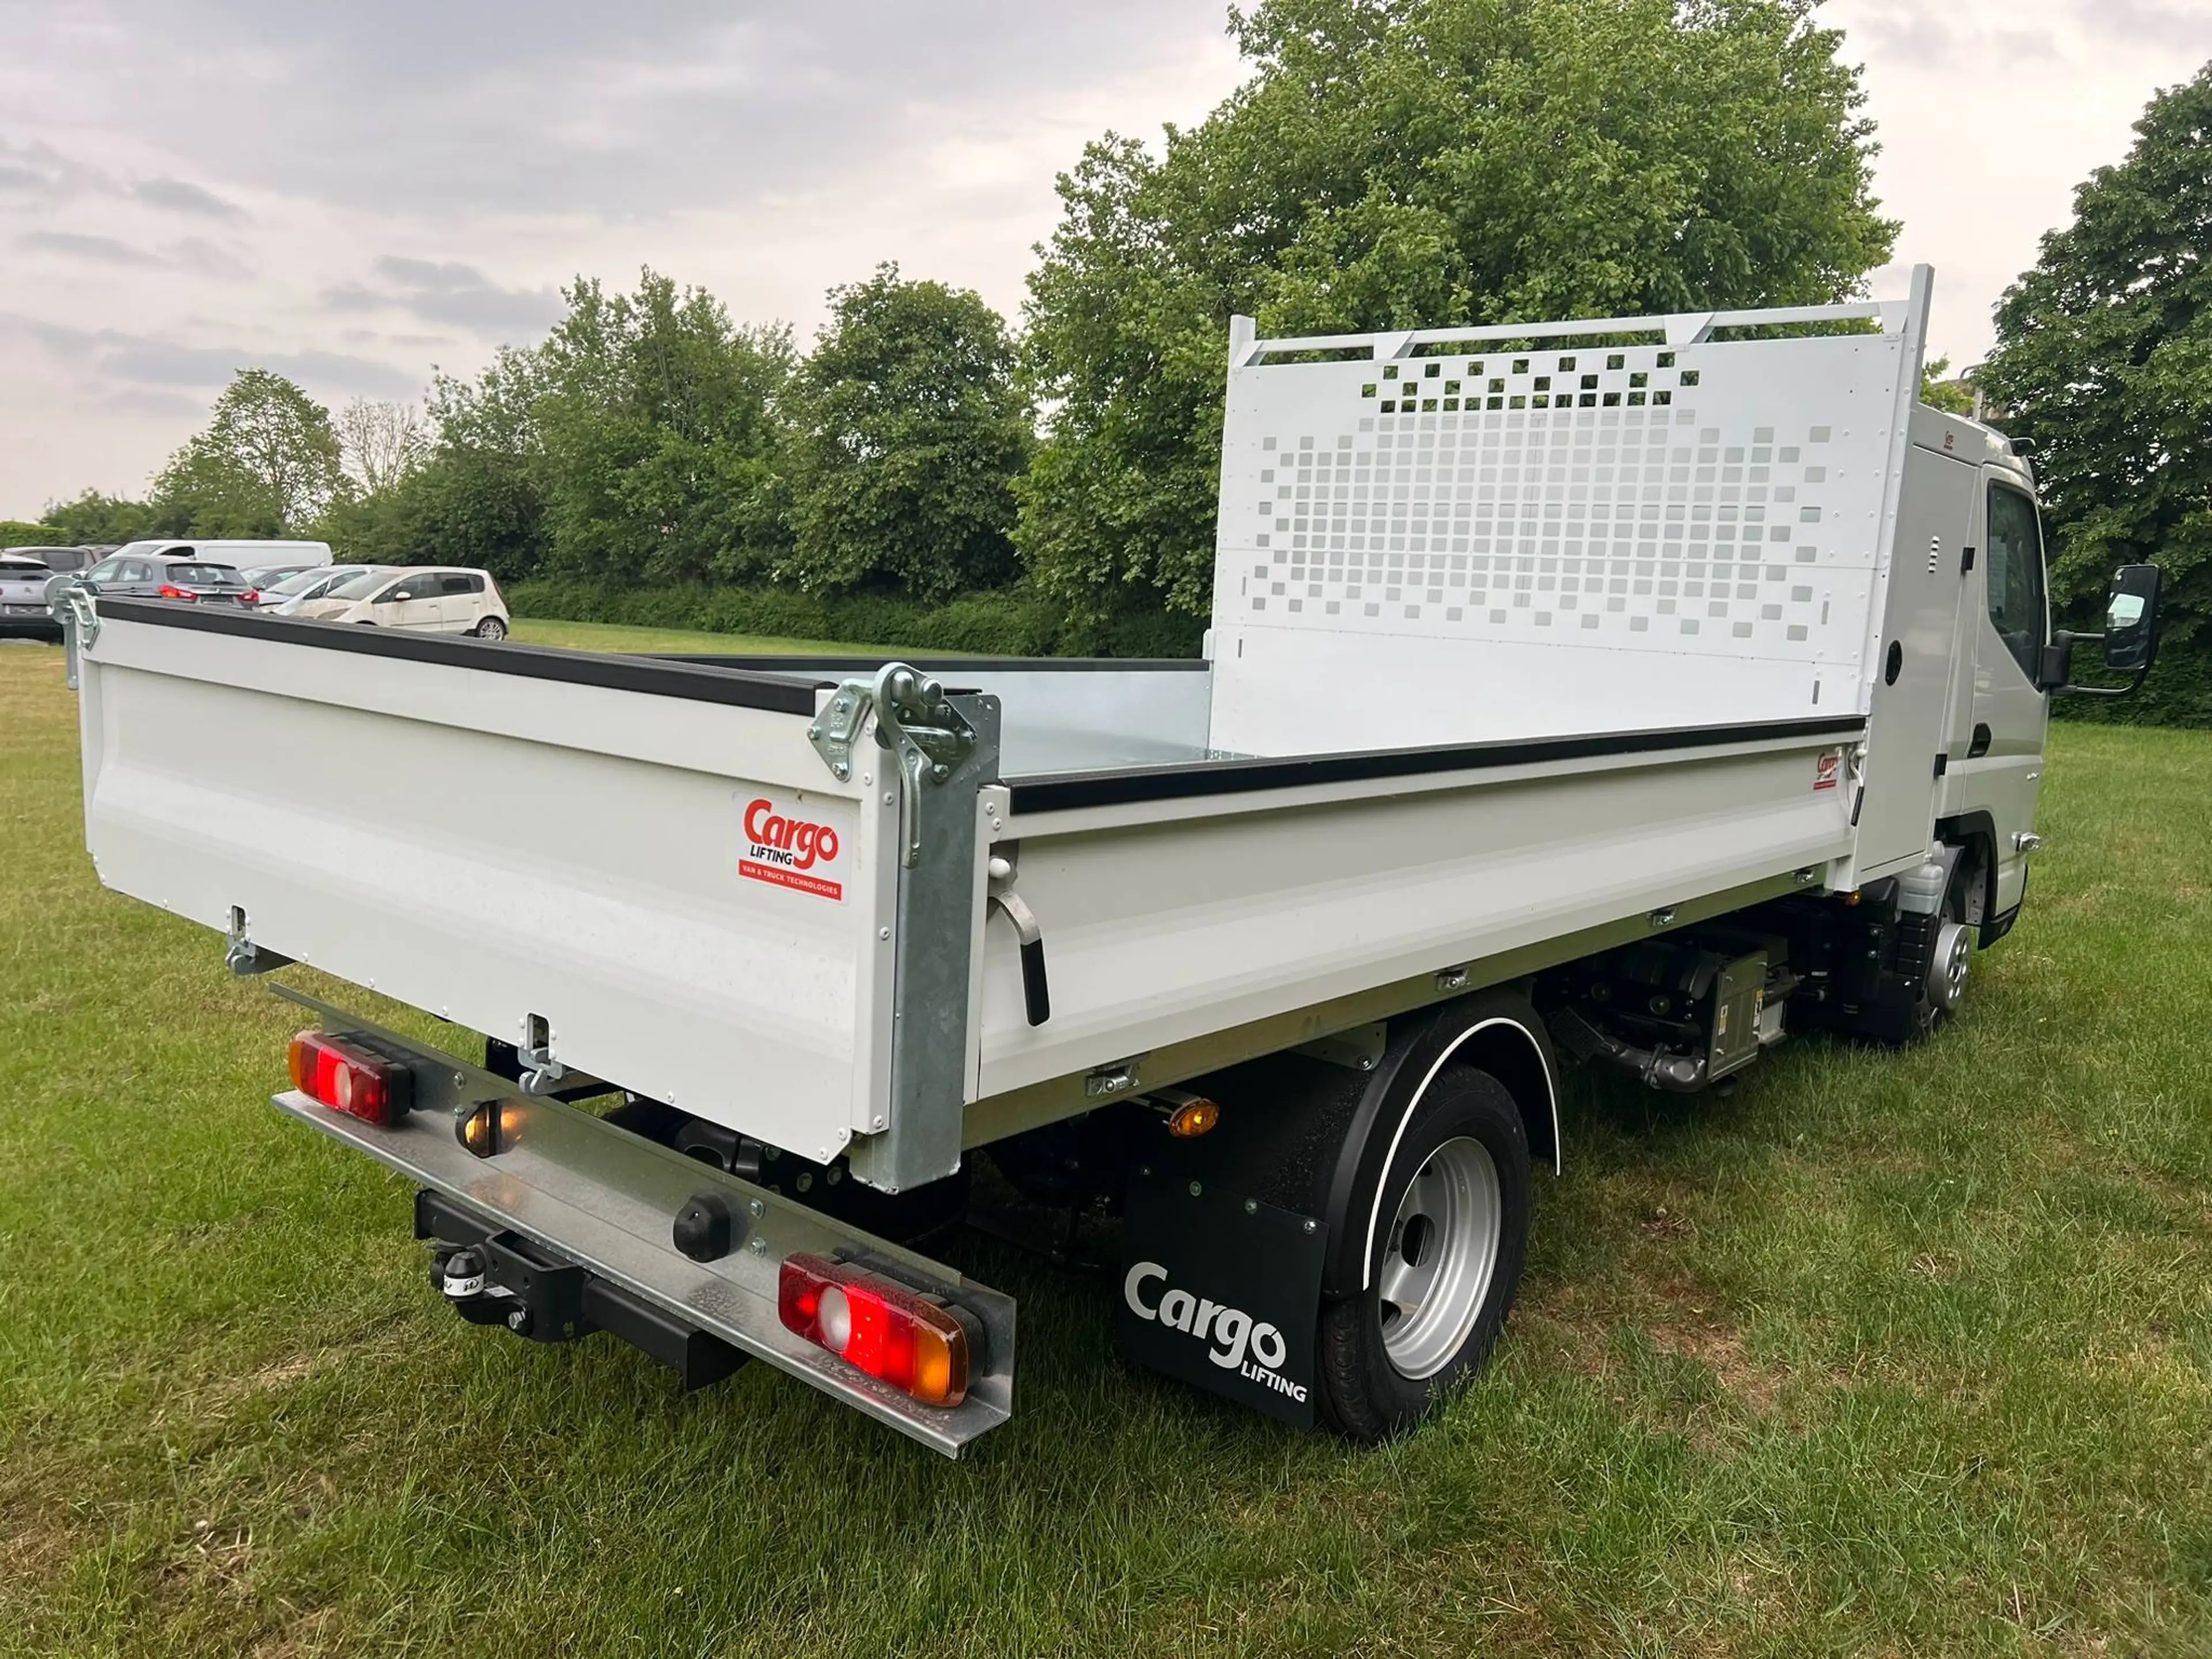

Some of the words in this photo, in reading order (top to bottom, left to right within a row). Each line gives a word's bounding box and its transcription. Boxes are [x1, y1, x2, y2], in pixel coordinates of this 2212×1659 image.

[744, 799, 838, 869] Cargo
[750, 845, 793, 865] LIFTING
[743, 865, 756, 873] VAN
[764, 870, 785, 881] TRUCK
[786, 876, 838, 895] TECHNOLOGIES
[1125, 1262, 1286, 1369] Cargo
[1240, 1360, 1308, 1403] LIFTING
